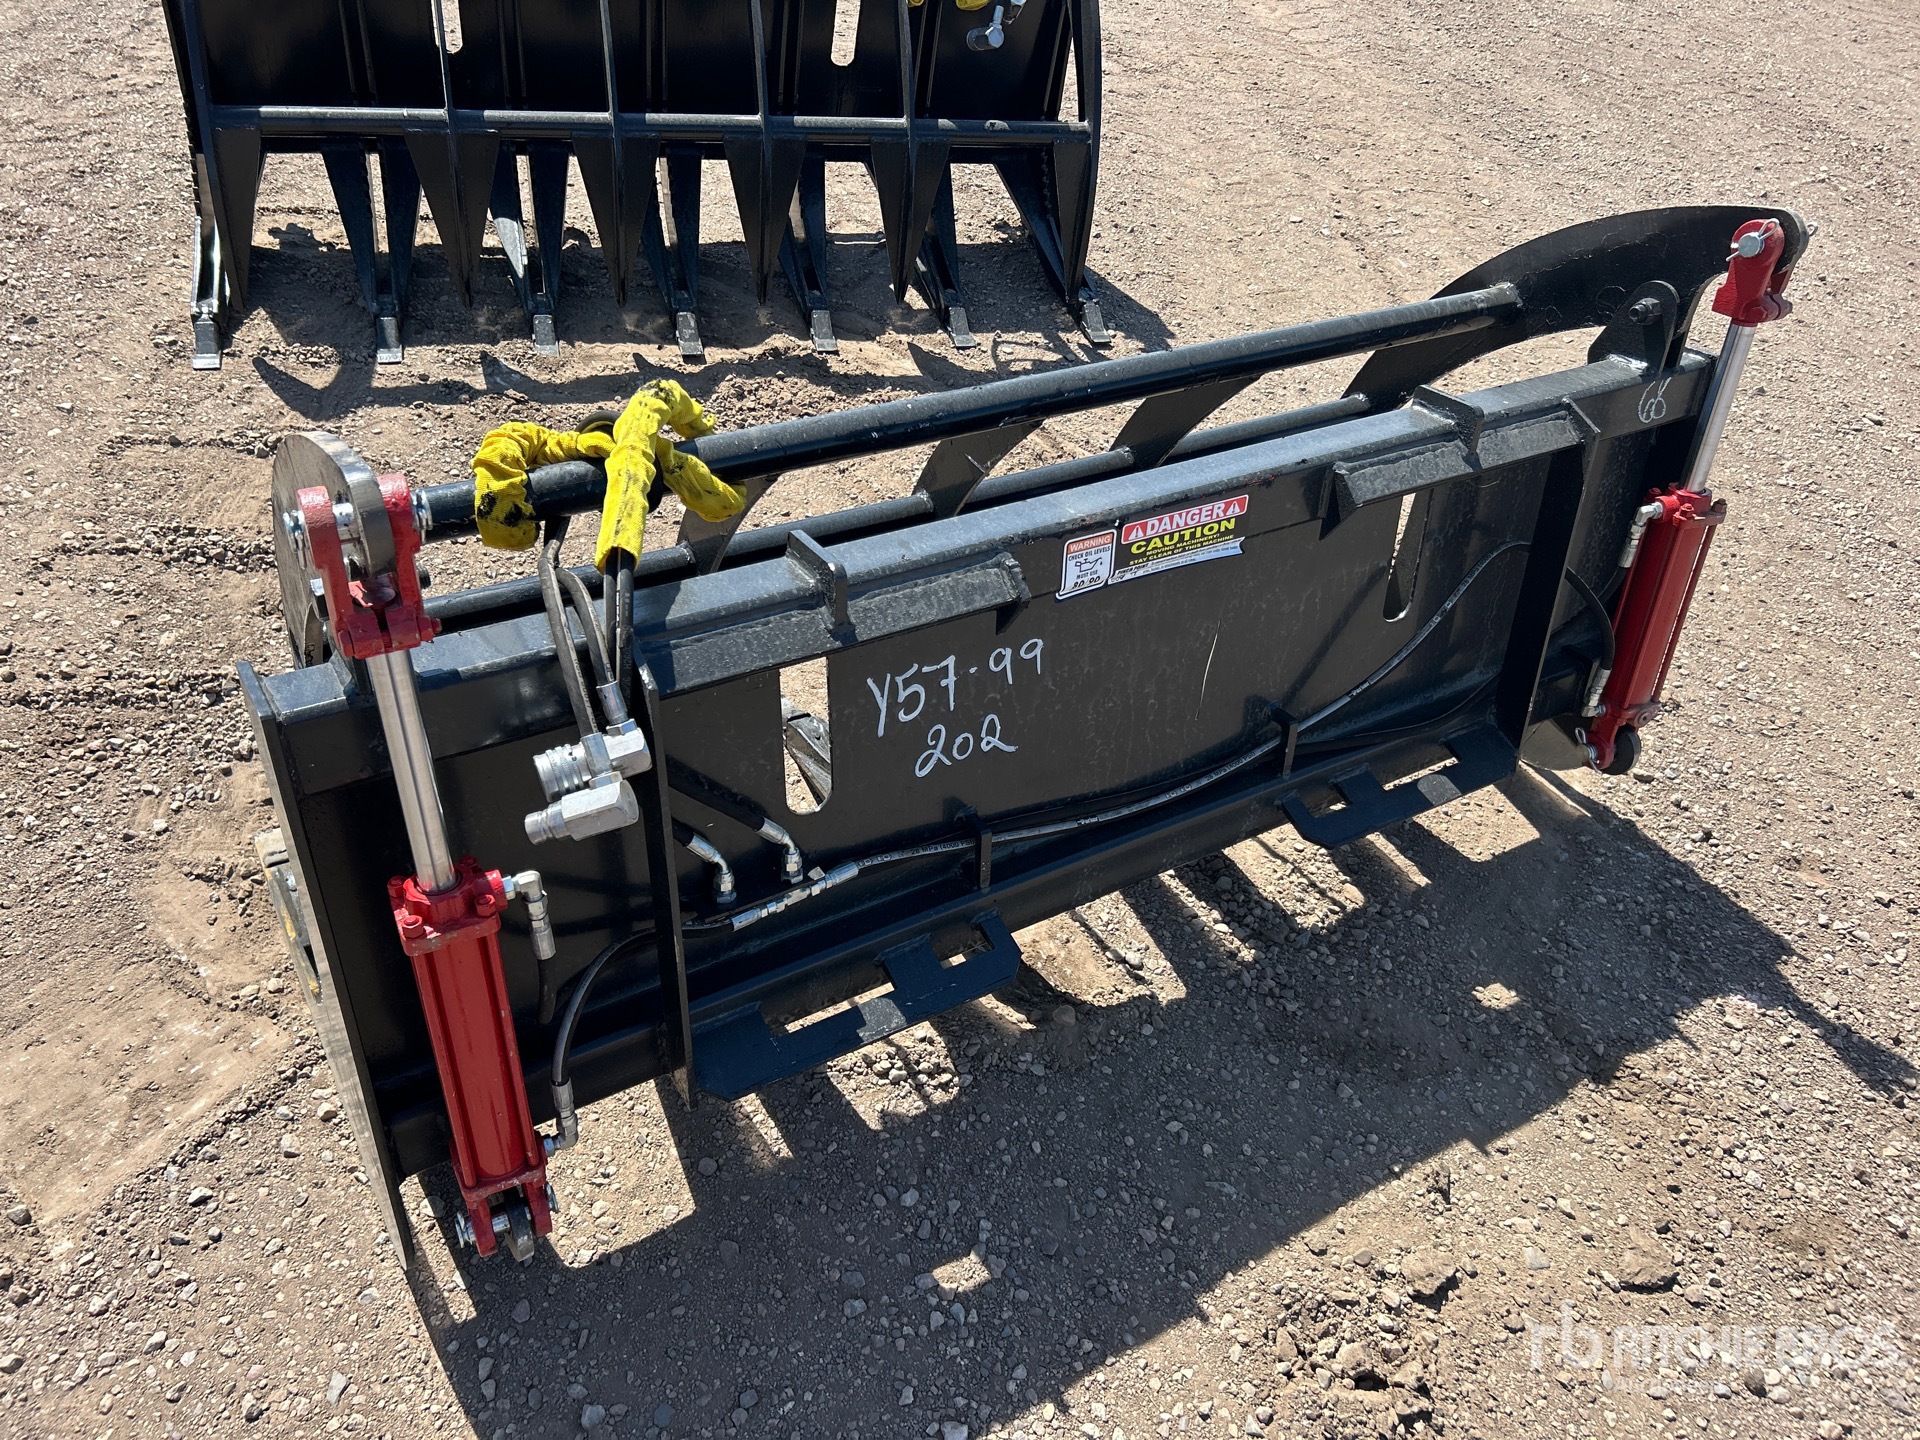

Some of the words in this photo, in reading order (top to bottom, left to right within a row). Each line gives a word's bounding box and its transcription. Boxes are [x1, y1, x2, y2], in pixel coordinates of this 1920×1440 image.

[1145, 502, 1226, 537] DANGER
[1070, 535, 1111, 553] WARNING
[1130, 518, 1236, 554] CAUTION
[1068, 552, 1084, 561] CHECK
[1094, 545, 1111, 555] LEVELS
[1129, 556, 1148, 566] STAY
[1149, 551, 1173, 561] CLEAR
[1185, 543, 1202, 551] THIS
[1203, 534, 1235, 547] MACHINE
[1146, 545, 1175, 556] MOVING
[1076, 572, 1089, 580] MUST
[1089, 569, 1099, 577] USE
[914, 713, 1019, 778] 202
